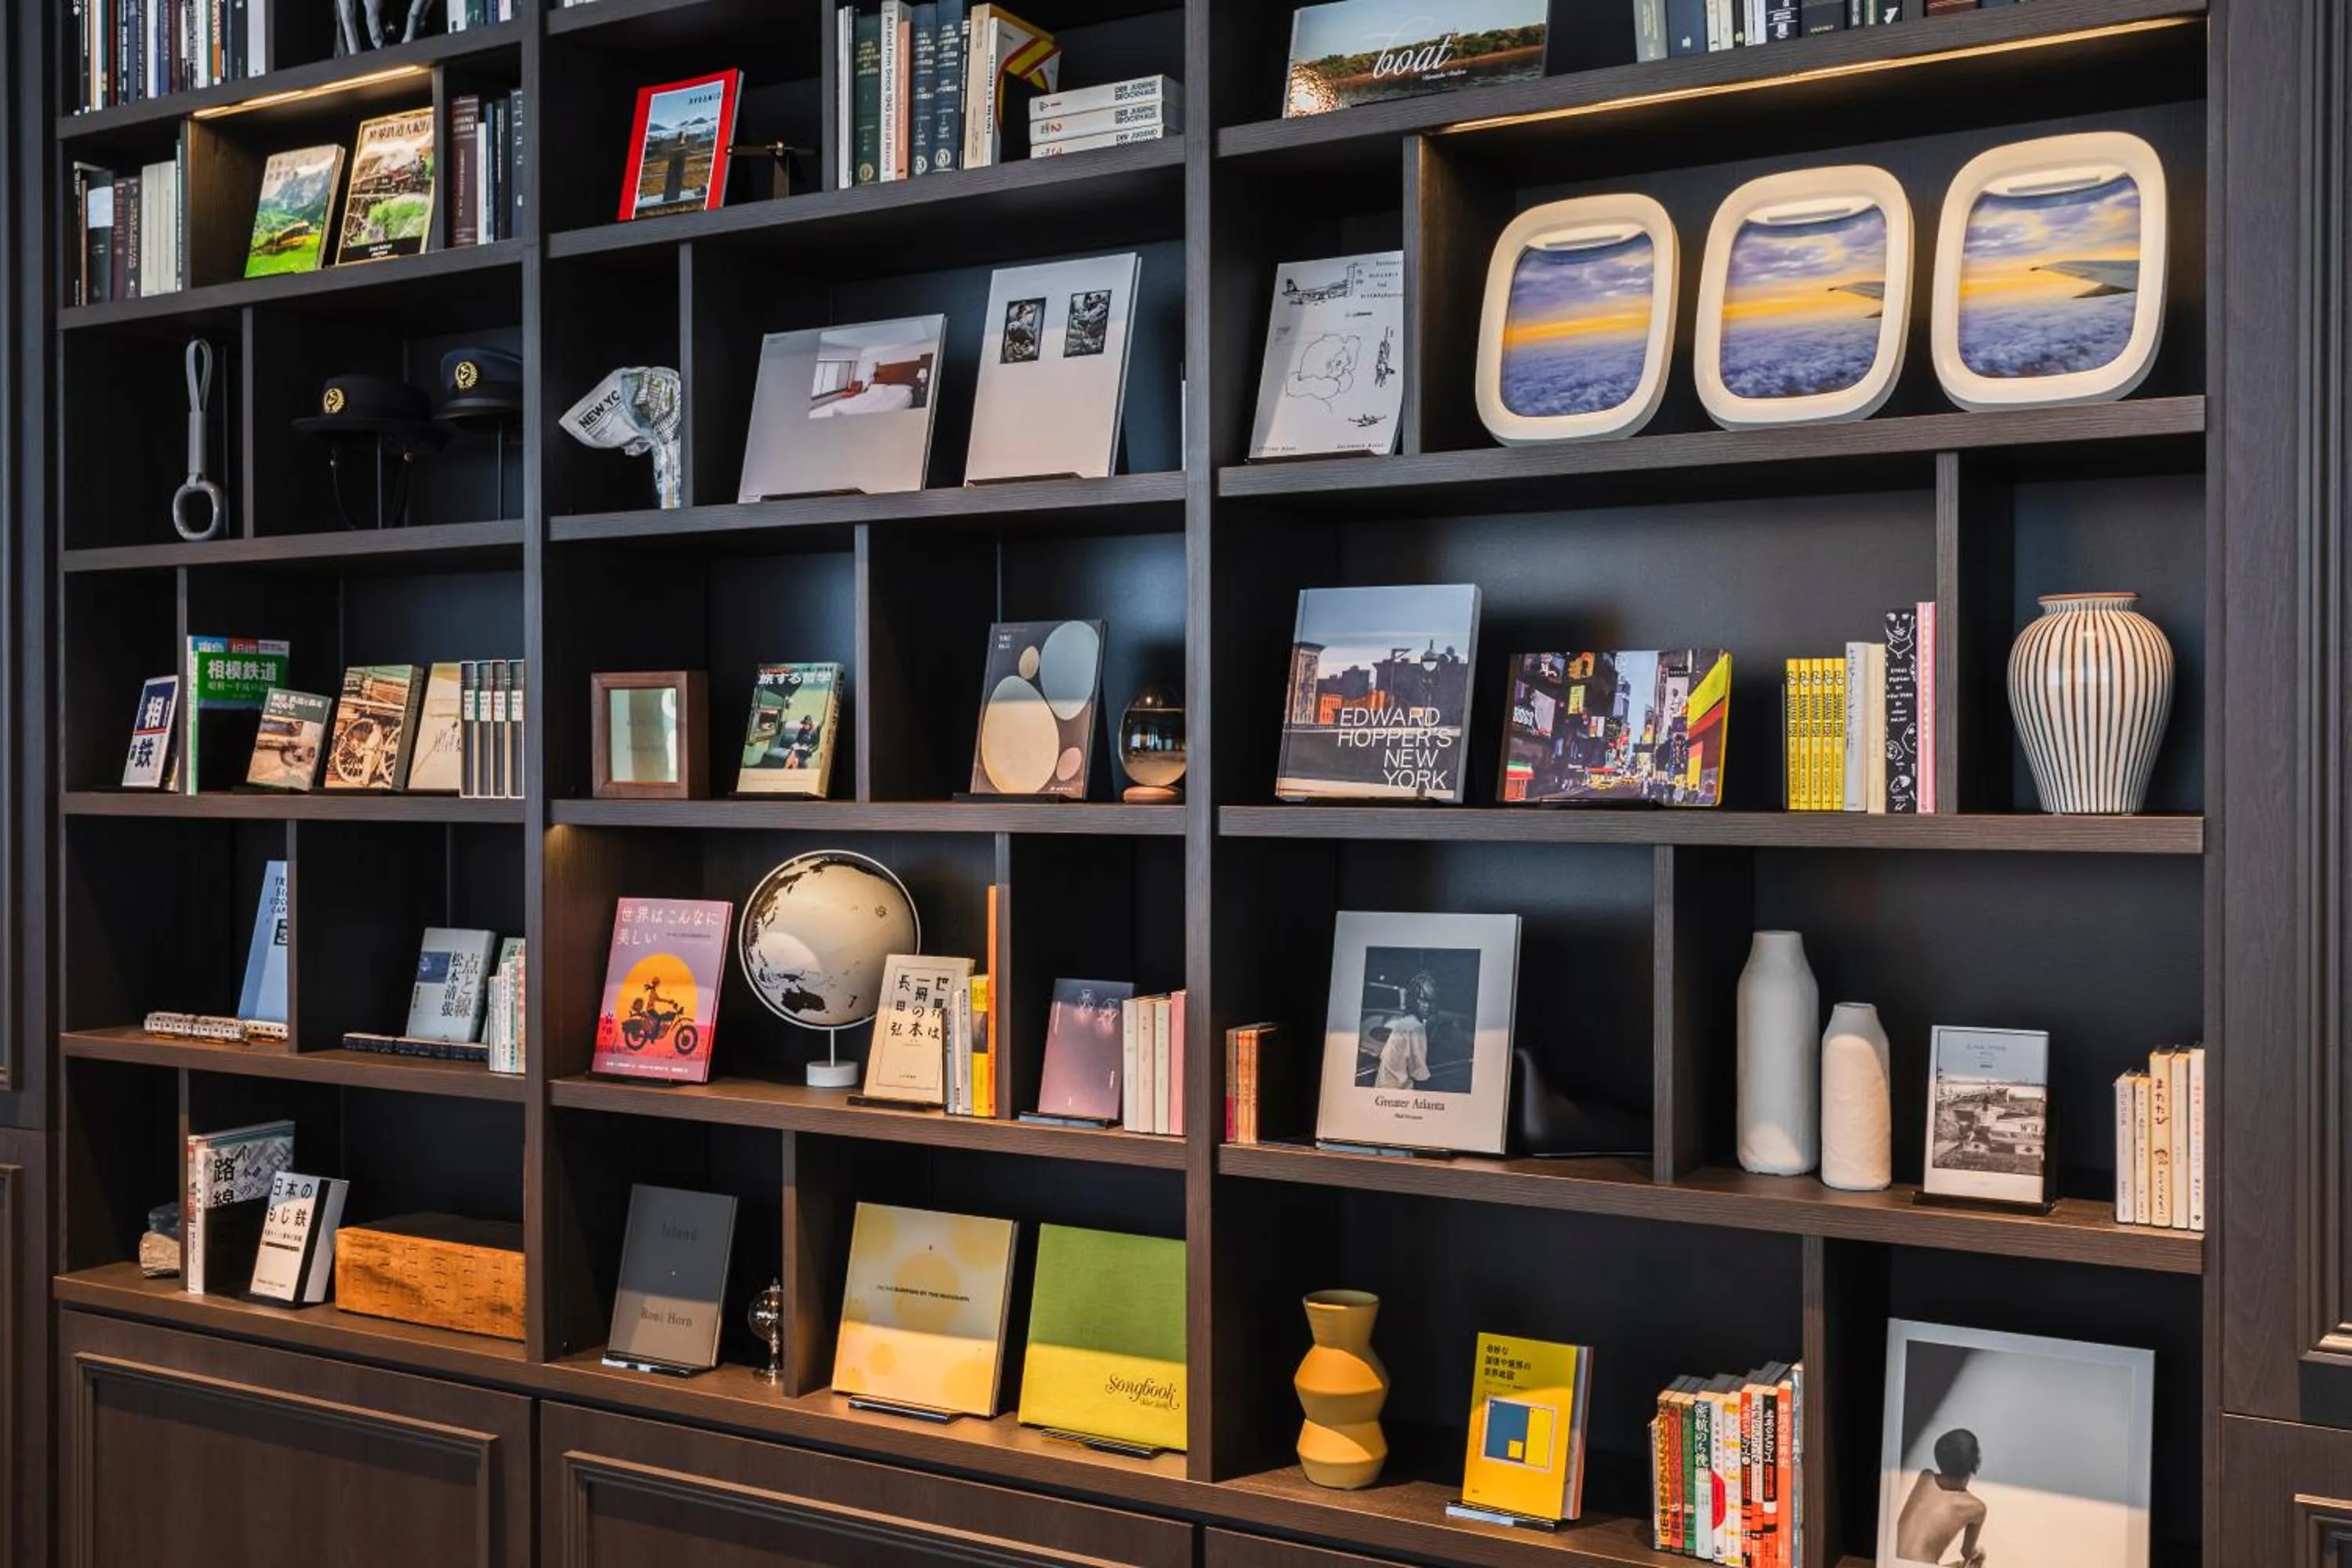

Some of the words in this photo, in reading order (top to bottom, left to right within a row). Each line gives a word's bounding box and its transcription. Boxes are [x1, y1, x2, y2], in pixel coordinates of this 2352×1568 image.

[1373, 33, 1453, 78] boat
[578, 403, 605, 429] NEW
[207, 659, 277, 681] 相模鉄道
[758, 673, 832, 685] 旅する哲学
[1340, 707, 1441, 727] EDWARD
[1338, 728, 1453, 748] HOPPER'S
[1384, 749, 1439, 768] NEW
[1383, 769, 1448, 790] YORK
[620, 906, 719, 927] 世界はこんなに
[617, 927, 658, 946] 美しい
[890, 974, 910, 1036] 長田弘
[907, 977, 931, 1038] 一冊の本
[1374, 1095, 1410, 1108] Greater
[1412, 1098, 1445, 1111] Atlanta
[272, 1178, 314, 1200] 日本の
[269, 1205, 308, 1228] もじ鉄
[1105, 1373, 1180, 1410] Songbook
